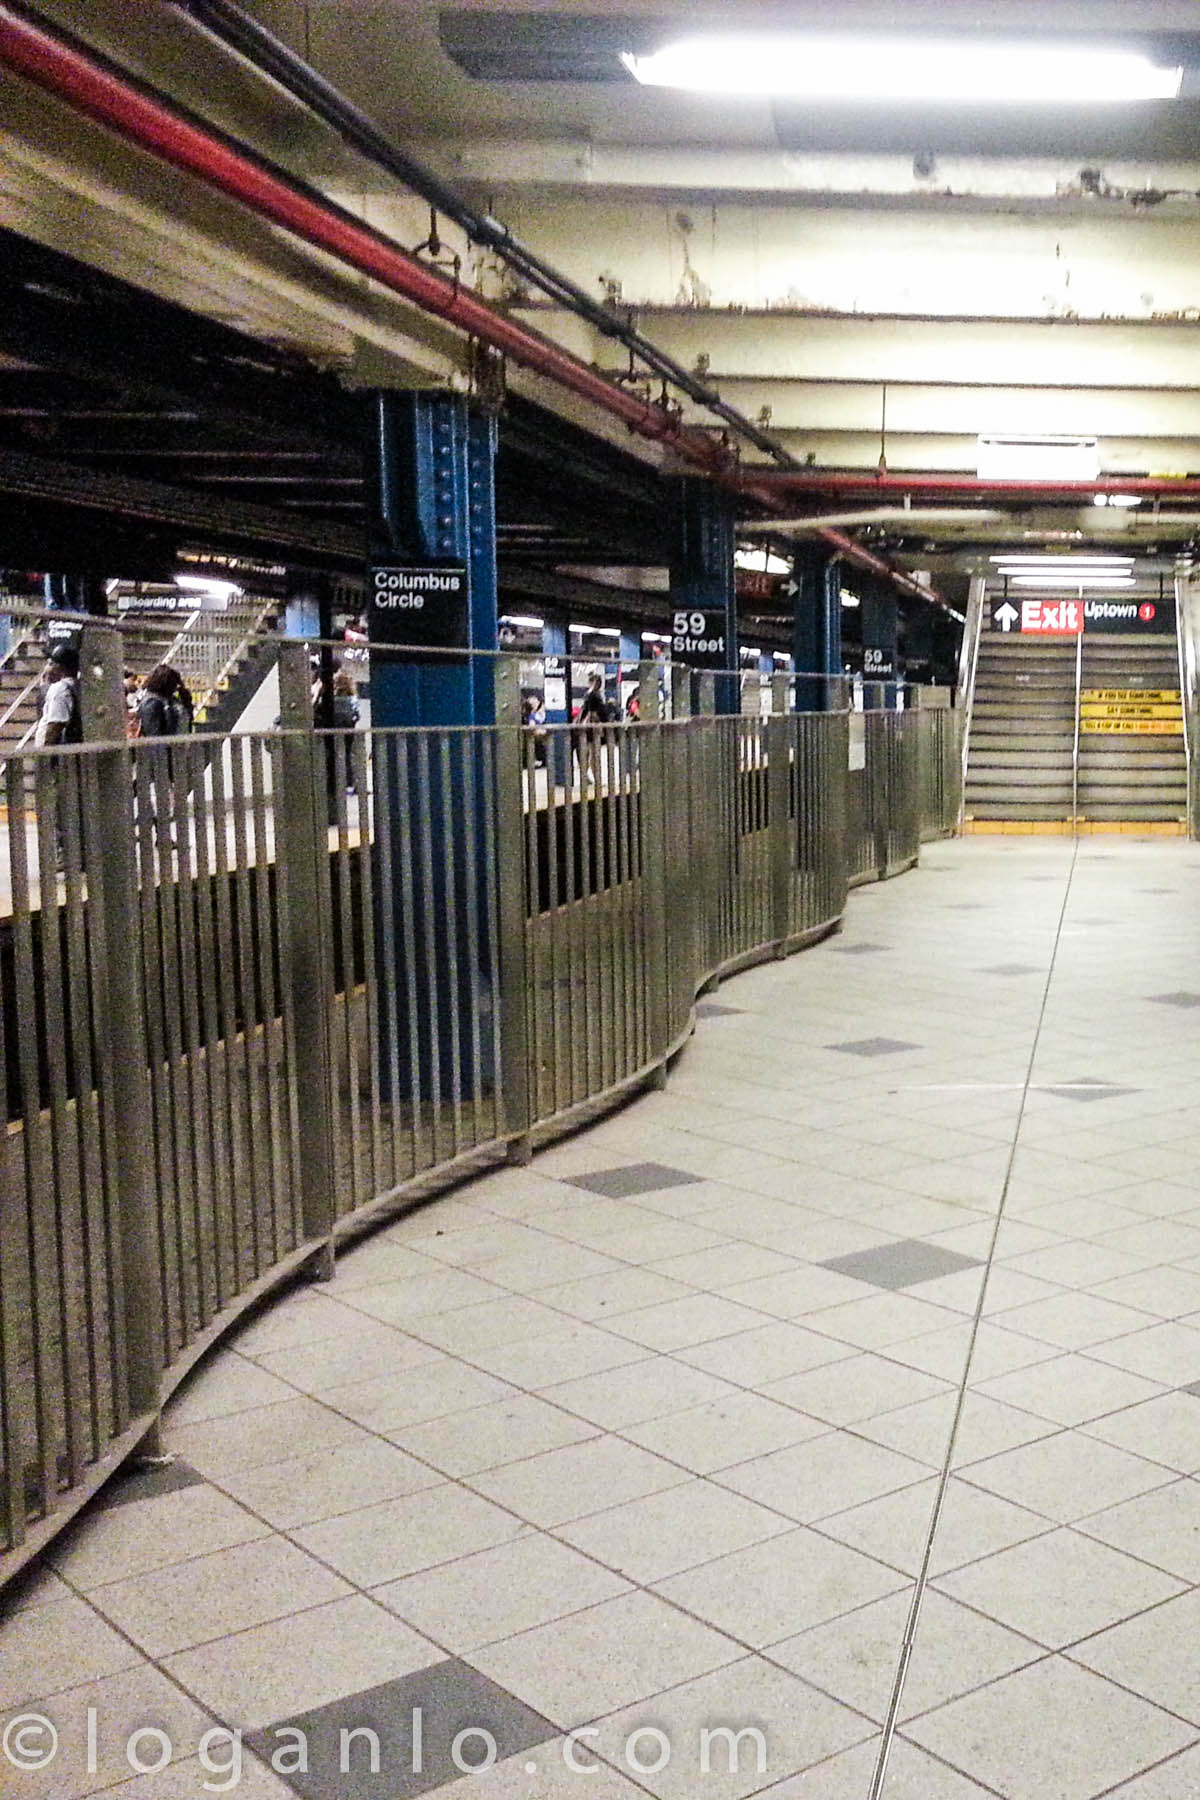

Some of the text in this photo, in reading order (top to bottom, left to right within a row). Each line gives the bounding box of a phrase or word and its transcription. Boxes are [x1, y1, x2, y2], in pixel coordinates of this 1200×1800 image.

[374, 572, 461, 590] Columbus
[374, 590, 425, 609] Circle
[673, 612, 706, 636] 59
[1021, 601, 1079, 629] Exit
[1084, 602, 1138, 620] Uptown
[673, 636, 725, 653] Street
[864, 648, 883, 664] 59
[864, 663, 893, 674] Street
